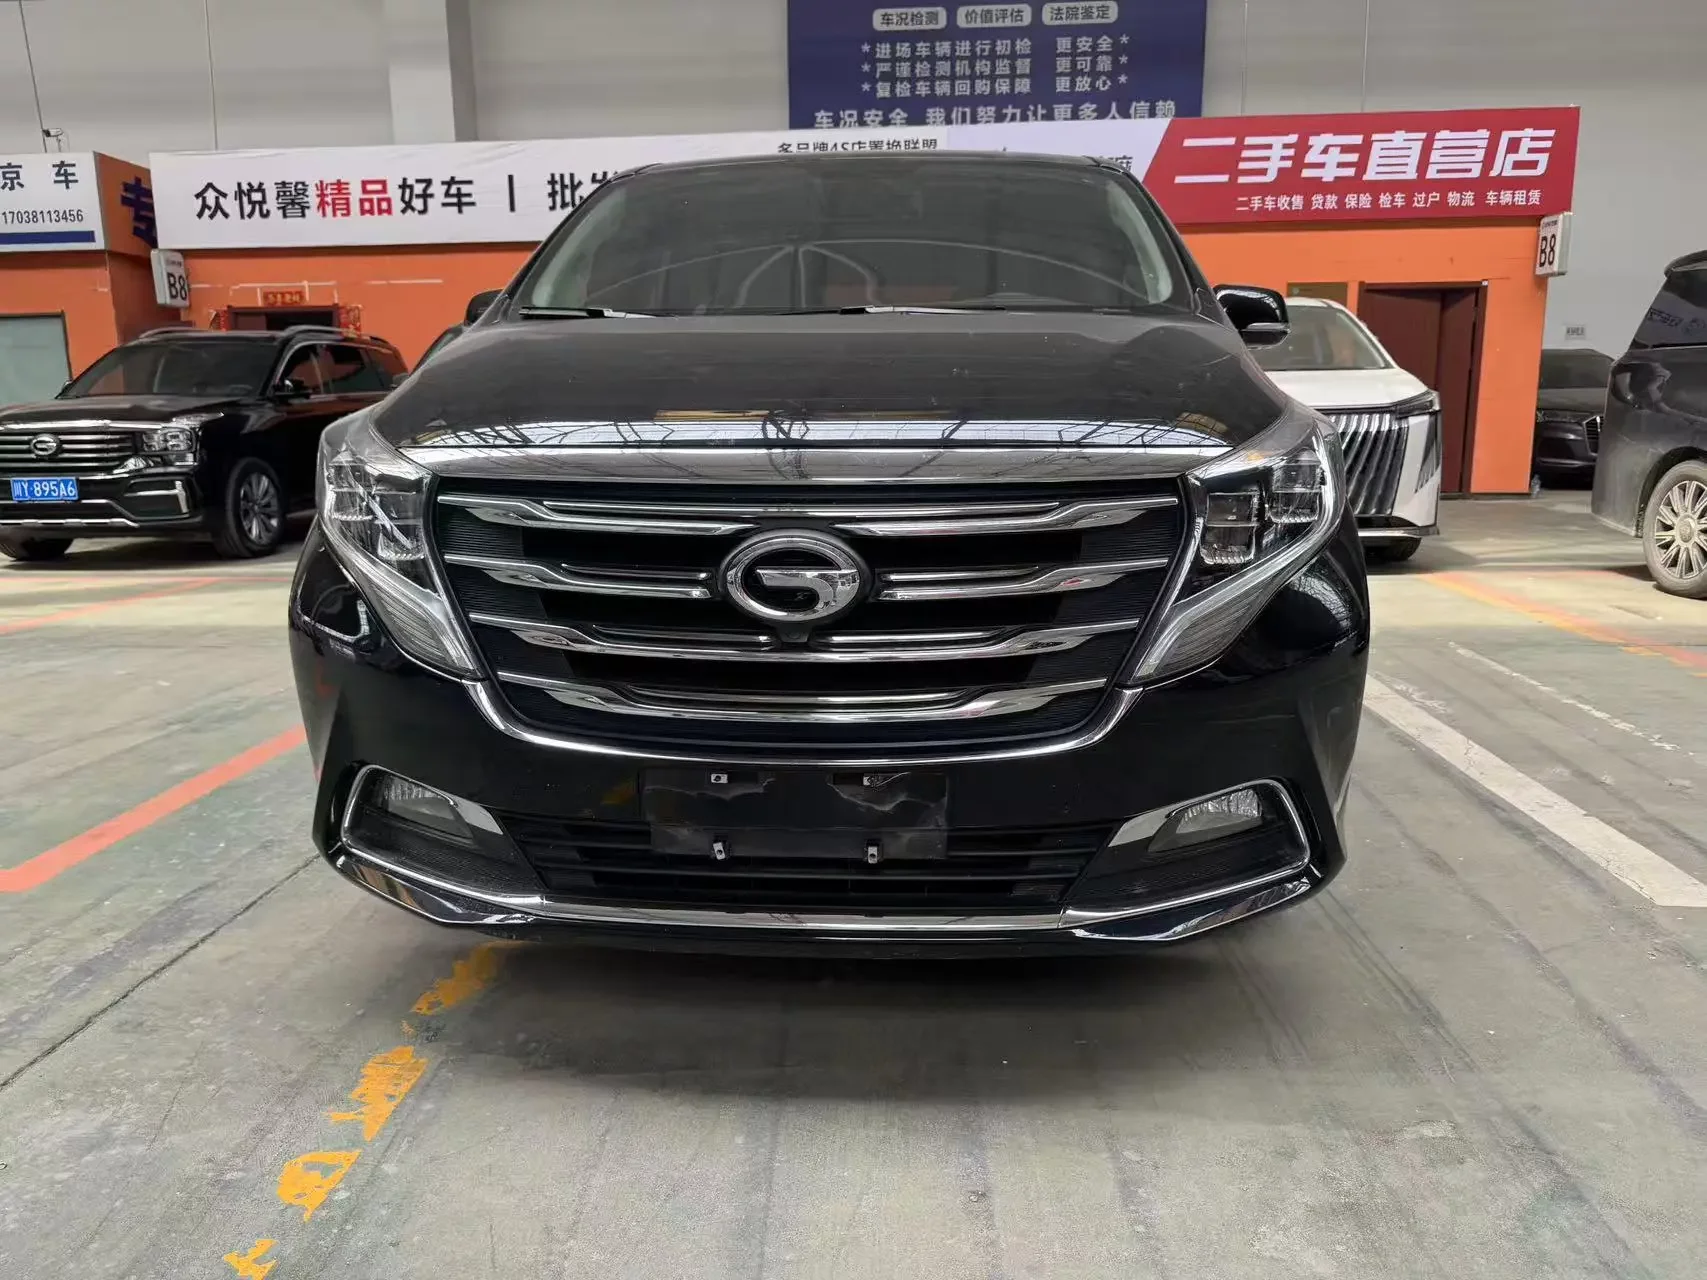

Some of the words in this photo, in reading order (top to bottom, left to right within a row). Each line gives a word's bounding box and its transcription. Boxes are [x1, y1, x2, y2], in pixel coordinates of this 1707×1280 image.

[880, 11, 939, 26] 车况检测
[964, 8, 1024, 24] 价值评估
[1050, 5, 1111, 21] 法院鉴定
[875, 38, 1032, 59] 进场车辆进行初检
[1056, 35, 1113, 53] 更安全
[1055, 55, 1113, 73] 更可靠
[875, 78, 1031, 98] 复检车辆回购保障
[1055, 75, 1112, 93] 更放心
[1174, 128, 1557, 184] 二手车直营店
[194, 176, 477, 220] 众悦馨精品好车
[1236, 195, 1304, 211] 二手车收售
[1311, 194, 1338, 210] 贷款
[1344, 193, 1373, 209] 保险
[1378, 192, 1406, 208] 检车
[1412, 191, 1440, 208] 过户
[1447, 190, 1475, 207] 物流
[1485, 189, 1542, 206] 车辆租赁
[2, 209, 84, 225] 17038113456
[1538, 233, 1557, 268] B8
[166, 272, 188, 301] B8
